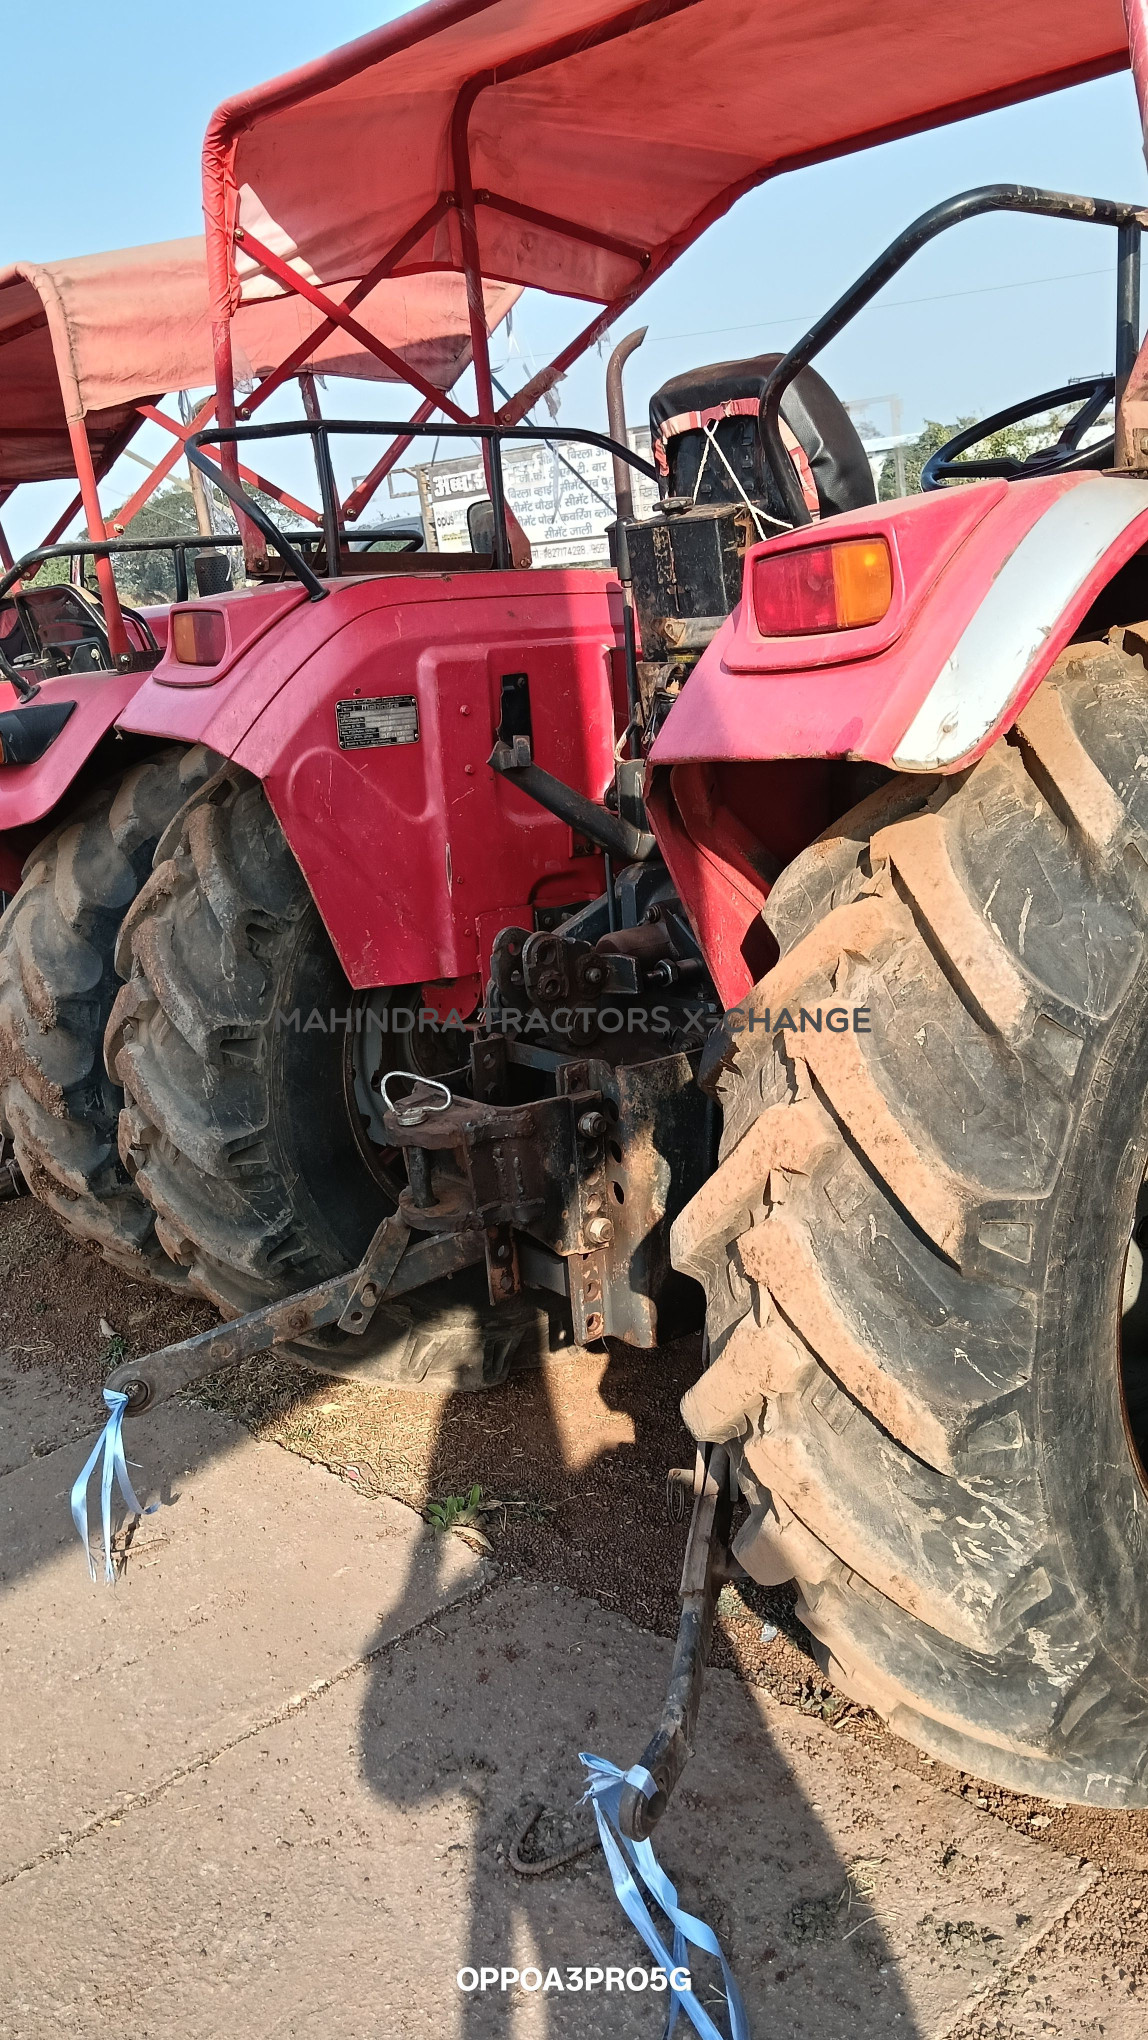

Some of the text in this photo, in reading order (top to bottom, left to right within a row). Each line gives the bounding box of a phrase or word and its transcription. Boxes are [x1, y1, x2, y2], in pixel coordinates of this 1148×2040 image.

[507, 487, 531, 499] बिरला
[565, 493, 589, 506] सीमेंट
[544, 522, 593, 539] सीमेंट जाली
